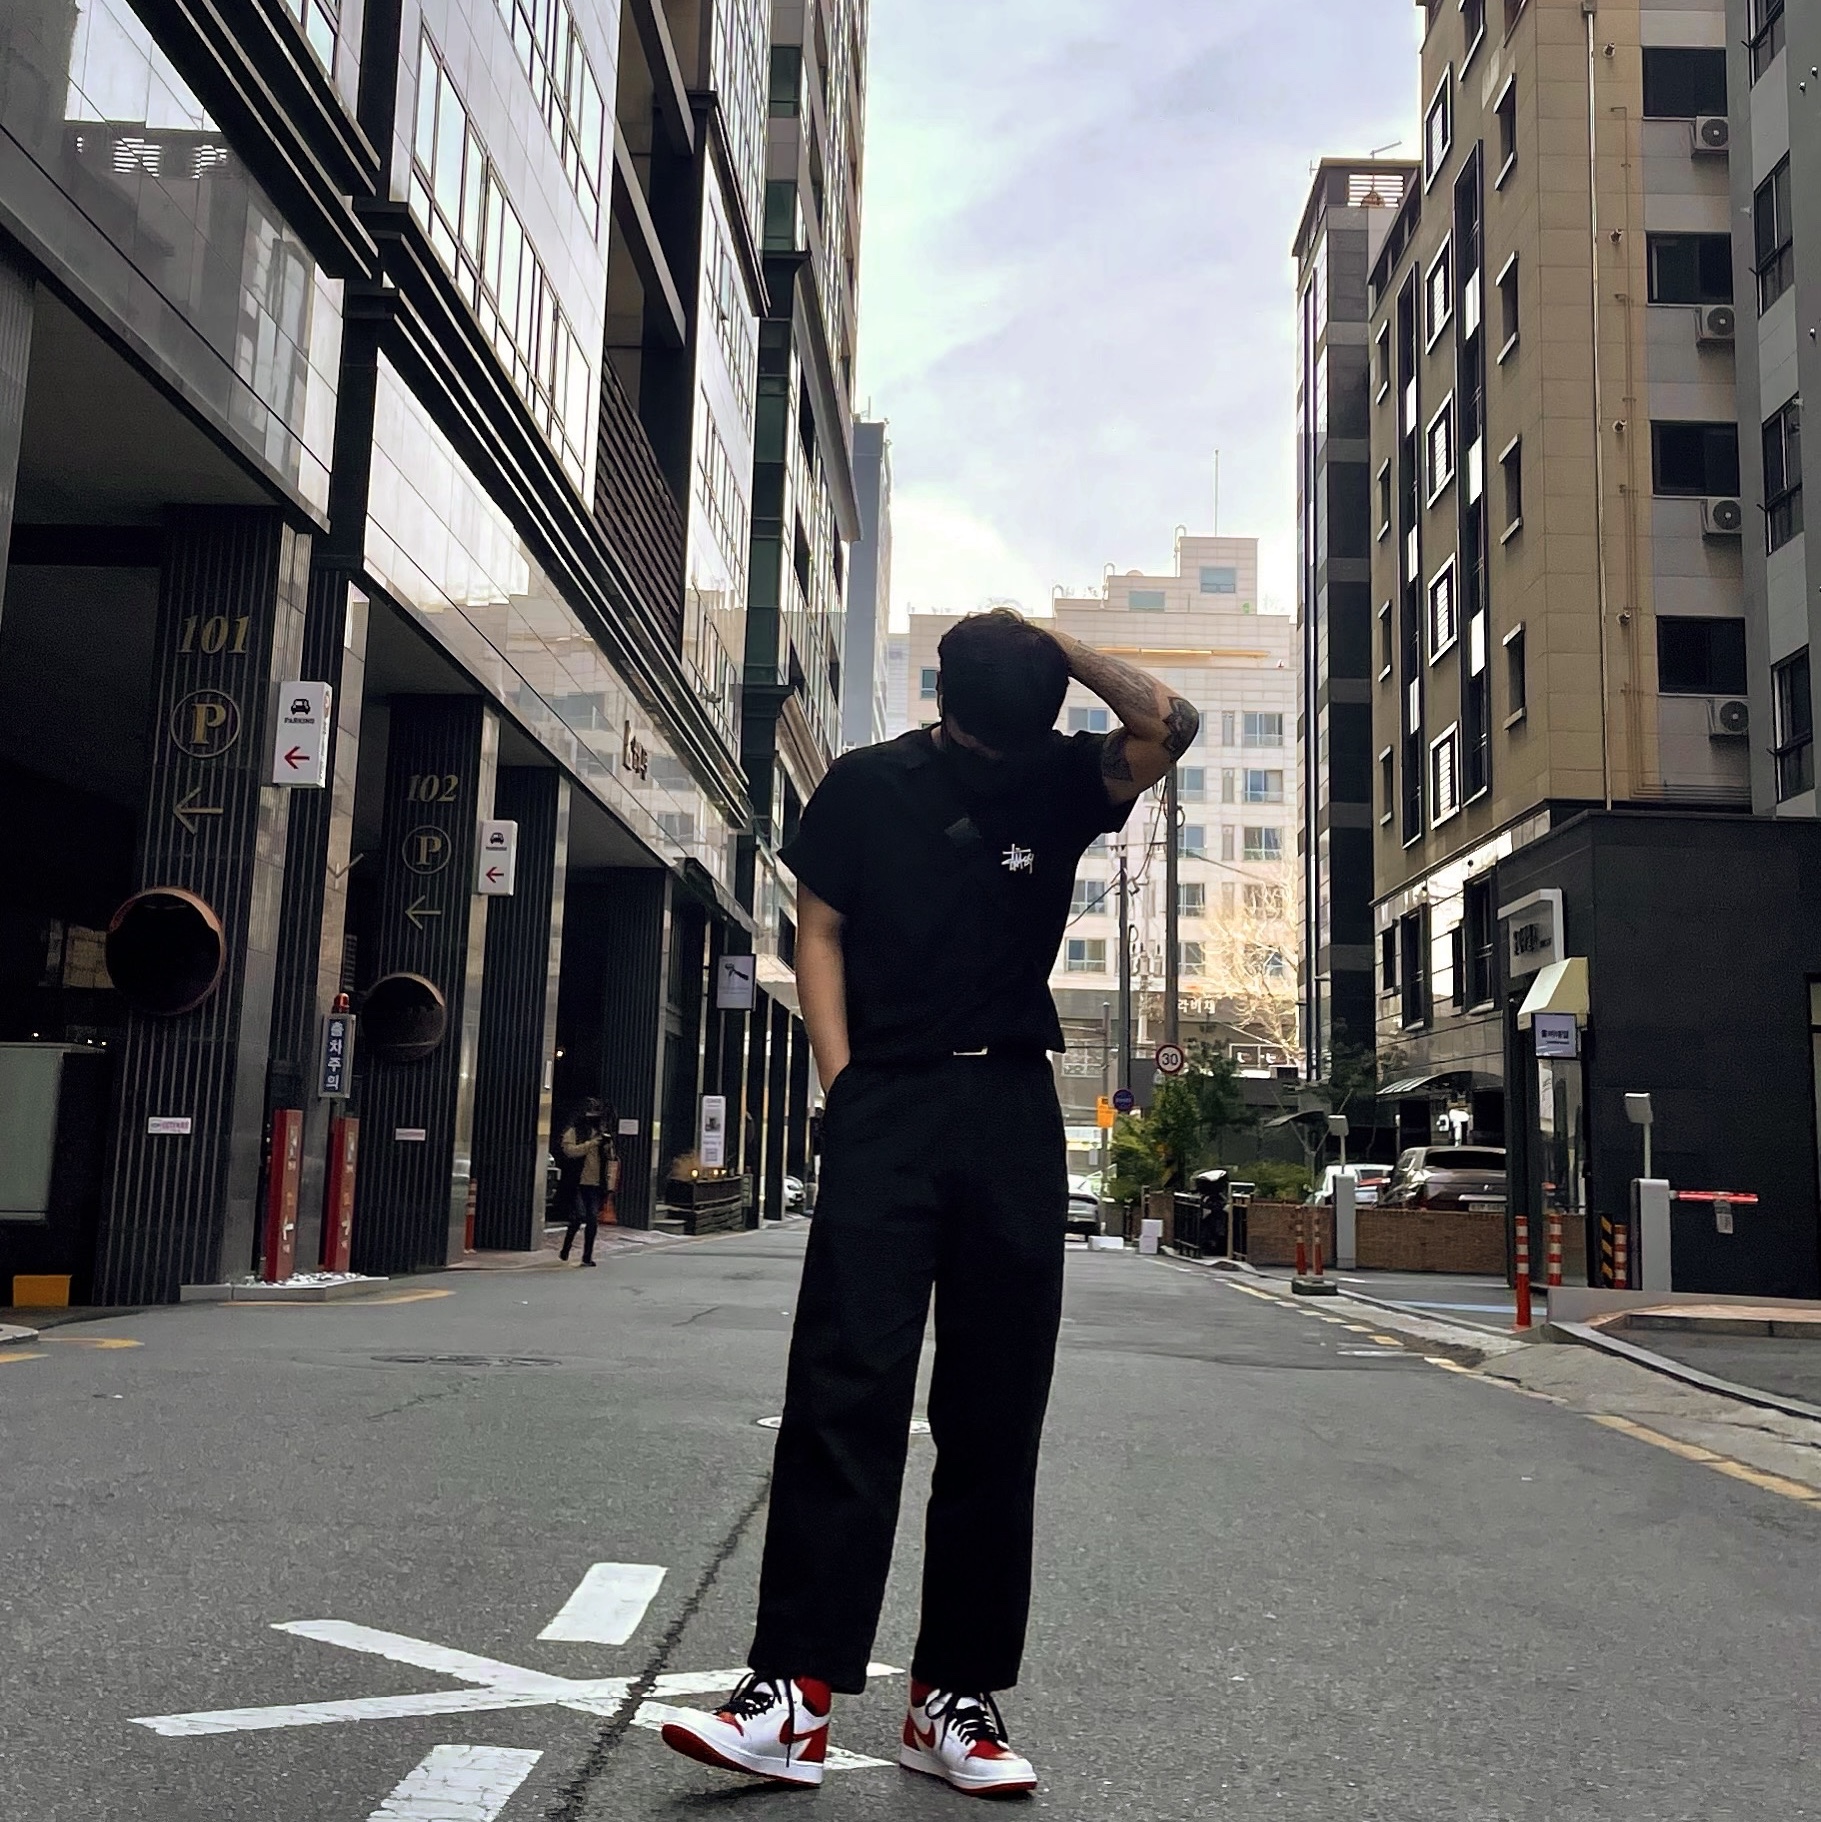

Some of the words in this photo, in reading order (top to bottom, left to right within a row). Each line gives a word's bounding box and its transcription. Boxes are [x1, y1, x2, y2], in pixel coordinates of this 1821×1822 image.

[176, 615, 250, 654] 101
[189, 703, 227, 745] P
[407, 774, 459, 802] 102
[415, 835, 442, 866] P
[1161, 1052, 1179, 1066] 30
